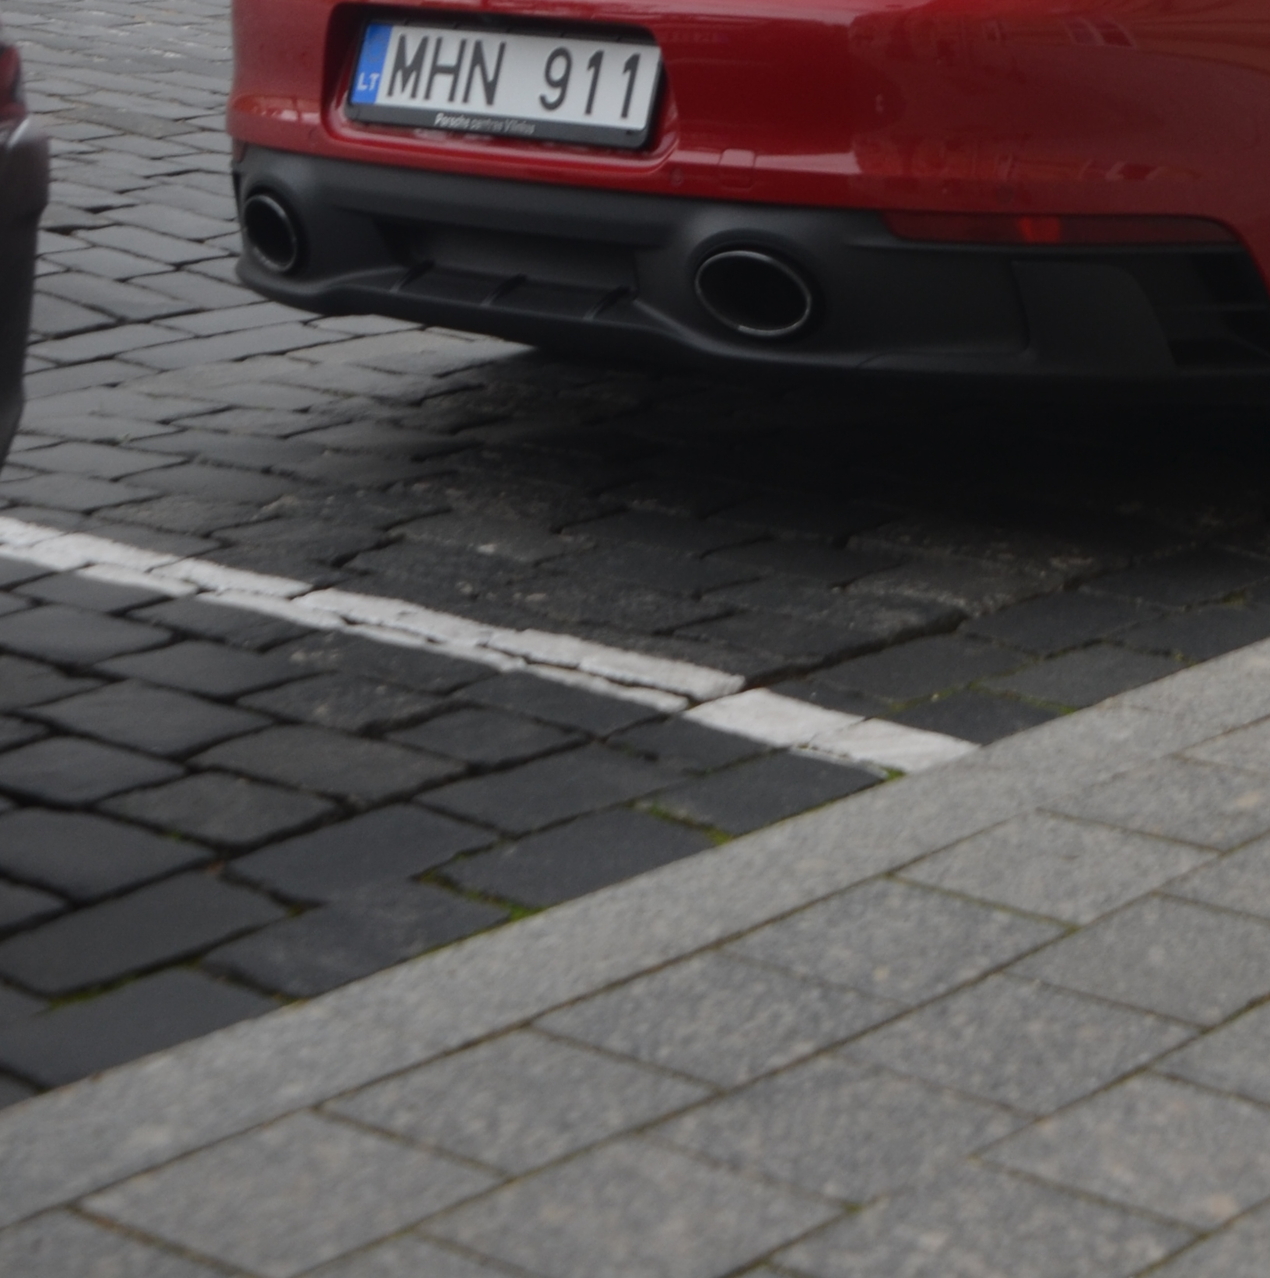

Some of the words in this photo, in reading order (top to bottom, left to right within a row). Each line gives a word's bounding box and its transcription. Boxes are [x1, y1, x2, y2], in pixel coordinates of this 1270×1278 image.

[356, 72, 380, 92] LT
[387, 33, 507, 106] MHN
[539, 46, 641, 120] 911
